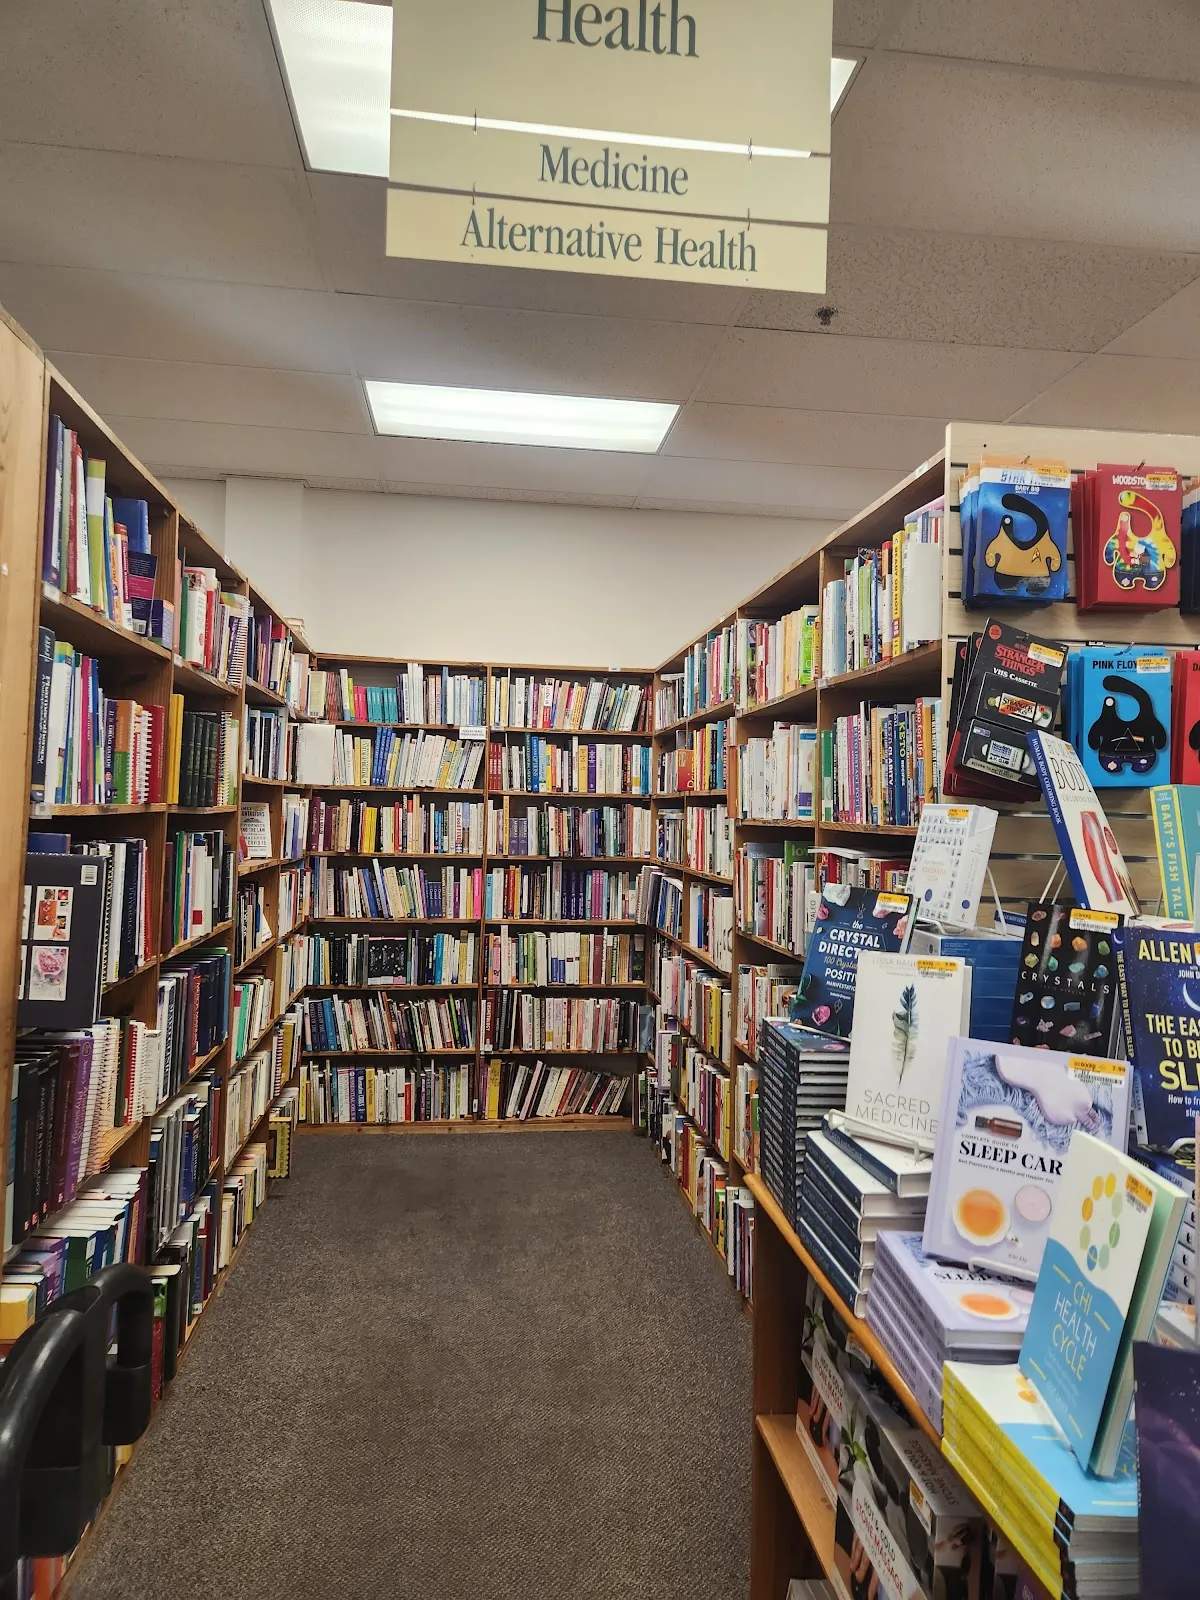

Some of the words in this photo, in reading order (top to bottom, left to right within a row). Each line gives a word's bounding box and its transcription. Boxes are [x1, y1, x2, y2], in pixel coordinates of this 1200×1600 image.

[532, 0, 699, 58] Health
[538, 143, 689, 195] Medicine
[460, 207, 643, 262] Alternative
[654, 225, 758, 272] Health
[993, 667, 1008, 678] VHS
[1001, 659, 1037, 677] THINGS
[1092, 661, 1114, 669] PINK
[1032, 738, 1043, 761] HUMAN
[1039, 760, 1049, 778] BODY
[1044, 776, 1057, 808] COLORING
[1051, 806, 1062, 824] BOOK
[1160, 804, 1175, 848] BART'S
[1167, 853, 1179, 881] FISH
[1171, 887, 1183, 918] TALE
[852, 920, 863, 929] the
[818, 941, 868, 959] DIRECT
[829, 928, 880, 948] CRYSTAL
[824, 956, 835, 965] 100
[1116, 950, 1124, 963] THE
[1139, 939, 1192, 964] ALLEN
[1021, 970, 1110, 994] CRYSTALS
[1118, 964, 1126, 981] EASY
[1178, 970, 1194, 979] JOHN
[1120, 981, 1128, 998] WAY
[1122, 999, 1129, 1008] TO
[1123, 1009, 1131, 1035] BETTER
[1145, 1013, 1175, 1035] THE
[1162, 1037, 1183, 1057] TO
[864, 1090, 931, 1115] SACRED
[1168, 1094, 1183, 1105] How
[1184, 1096, 1192, 1105] to
[855, 1104, 939, 1134] MEDICINE
[959, 1141, 1017, 1165] SLEEP
[1022, 1153, 1063, 1176] CAR
[1073, 1281, 1092, 1315] CHI
[1054, 1291, 1098, 1358] HEALTH
[1053, 1324, 1087, 1381] CYCLE
